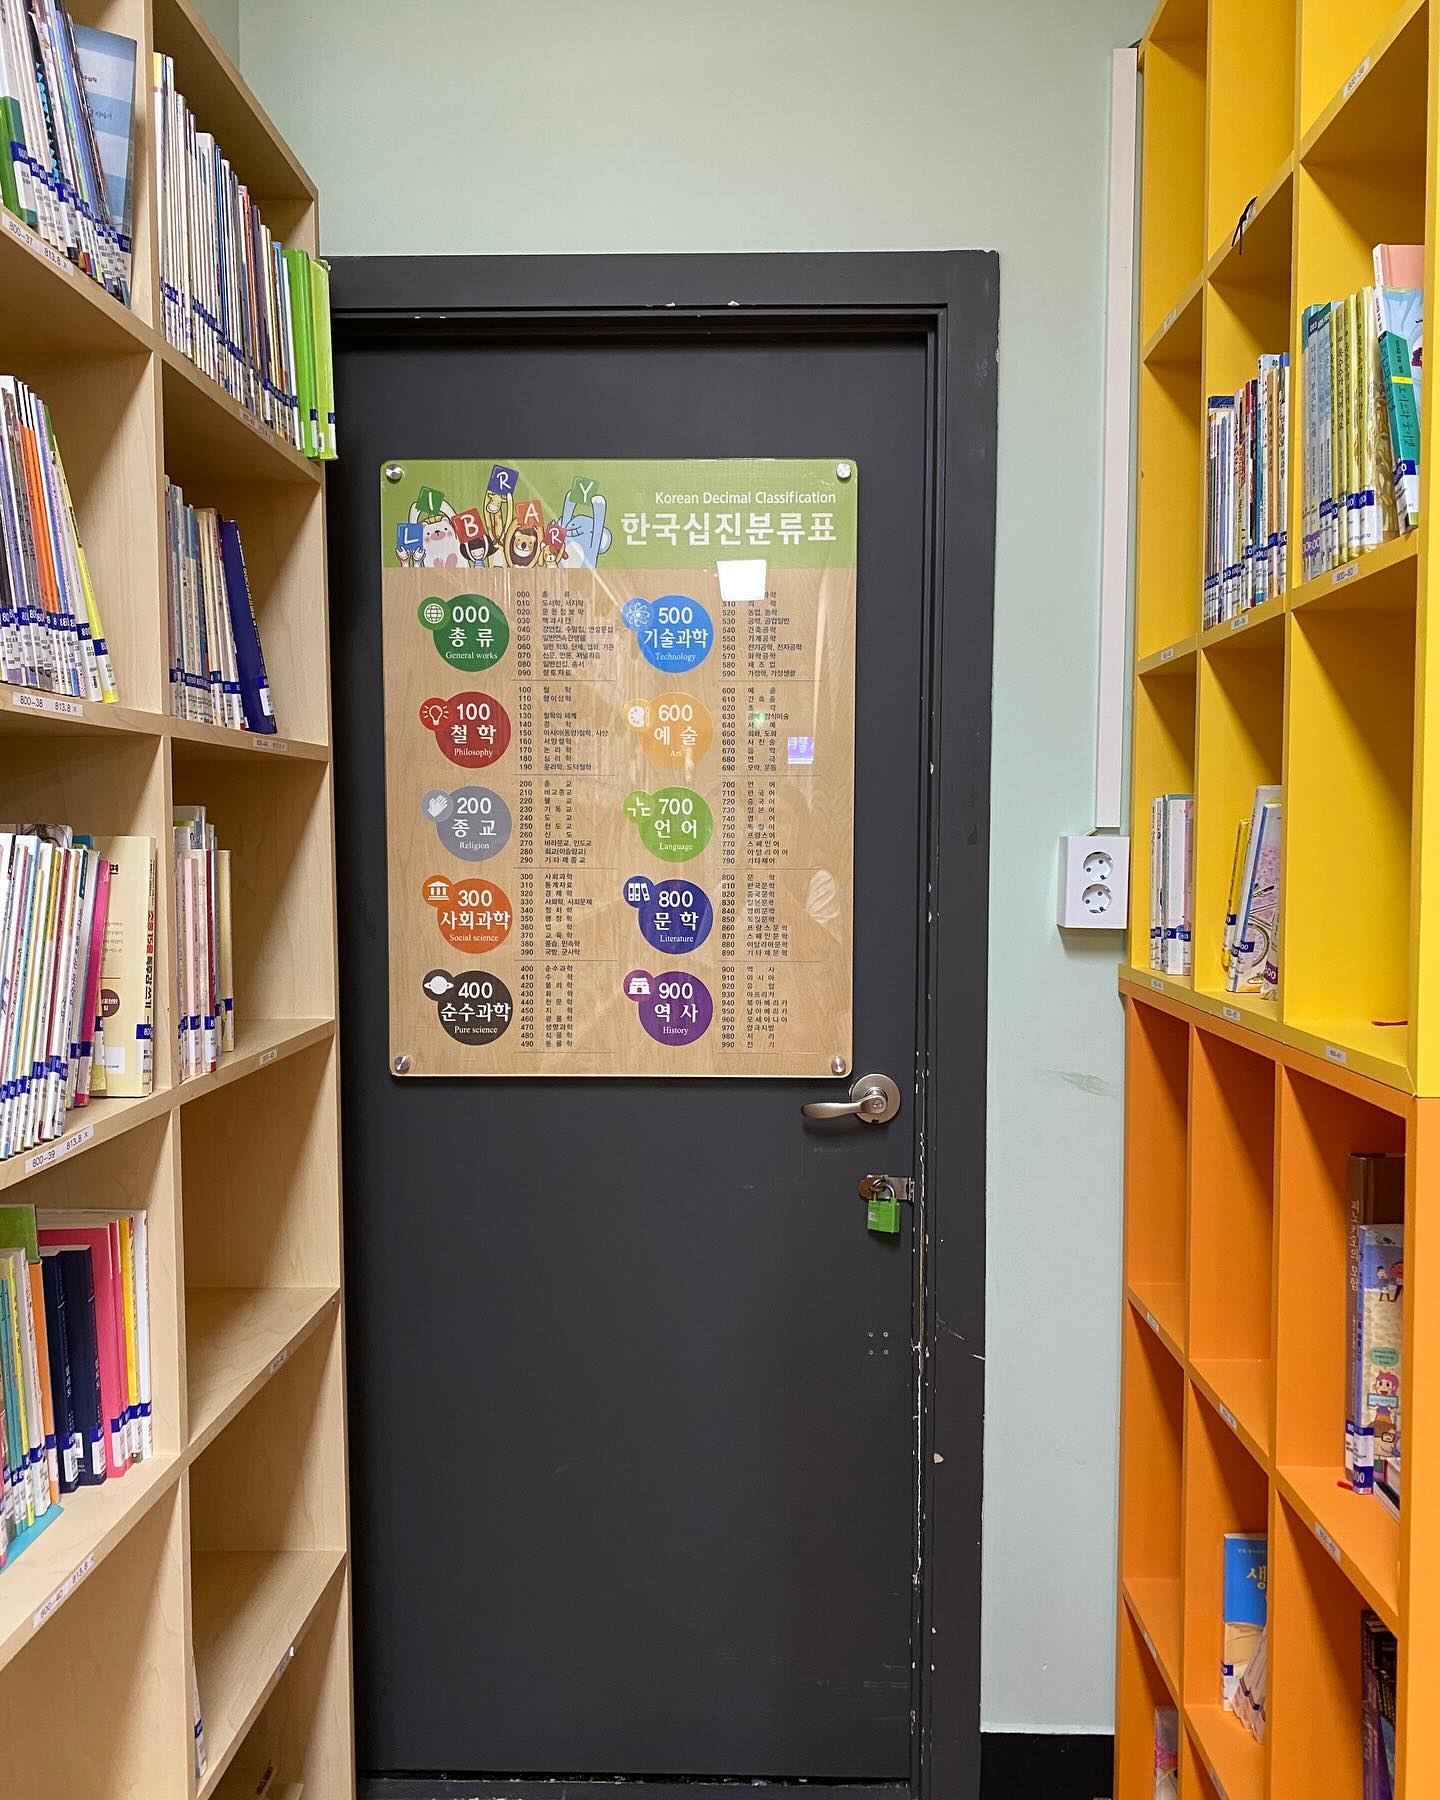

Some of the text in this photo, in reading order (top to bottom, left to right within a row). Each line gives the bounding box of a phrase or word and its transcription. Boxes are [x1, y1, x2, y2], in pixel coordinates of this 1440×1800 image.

[9, 221, 33, 245] 800-37
[655, 491, 836, 504] Korean Decimal Classification
[620, 512, 837, 546] 한국십진분류표
[452, 606, 490, 623] 000
[658, 607, 693, 624] 500
[643, 629, 708, 649] 기술과학
[445, 651, 498, 659] General works
[655, 652, 697, 662] Technology
[19, 695, 71, 713] 800-38 813.8
[456, 703, 490, 721] 100
[658, 705, 693, 722] 600
[454, 748, 493, 757] Philosophy
[457, 797, 492, 814] 200
[659, 798, 693, 815] 700
[459, 841, 490, 850] Religion
[659, 842, 693, 851] Language
[457, 890, 493, 907] 300
[658, 891, 693, 908] 800
[440, 911, 511, 931] 사회과학
[449, 934, 499, 942] Social science
[659, 934, 694, 943] Literature
[458, 982, 493, 999] 400
[658, 983, 693, 999] 900
[441, 1002, 511, 1022] 순수과학
[454, 1025, 498, 1034] Pure science
[663, 1026, 689, 1035] History
[32, 1134, 83, 1168] 800-39 813.8
